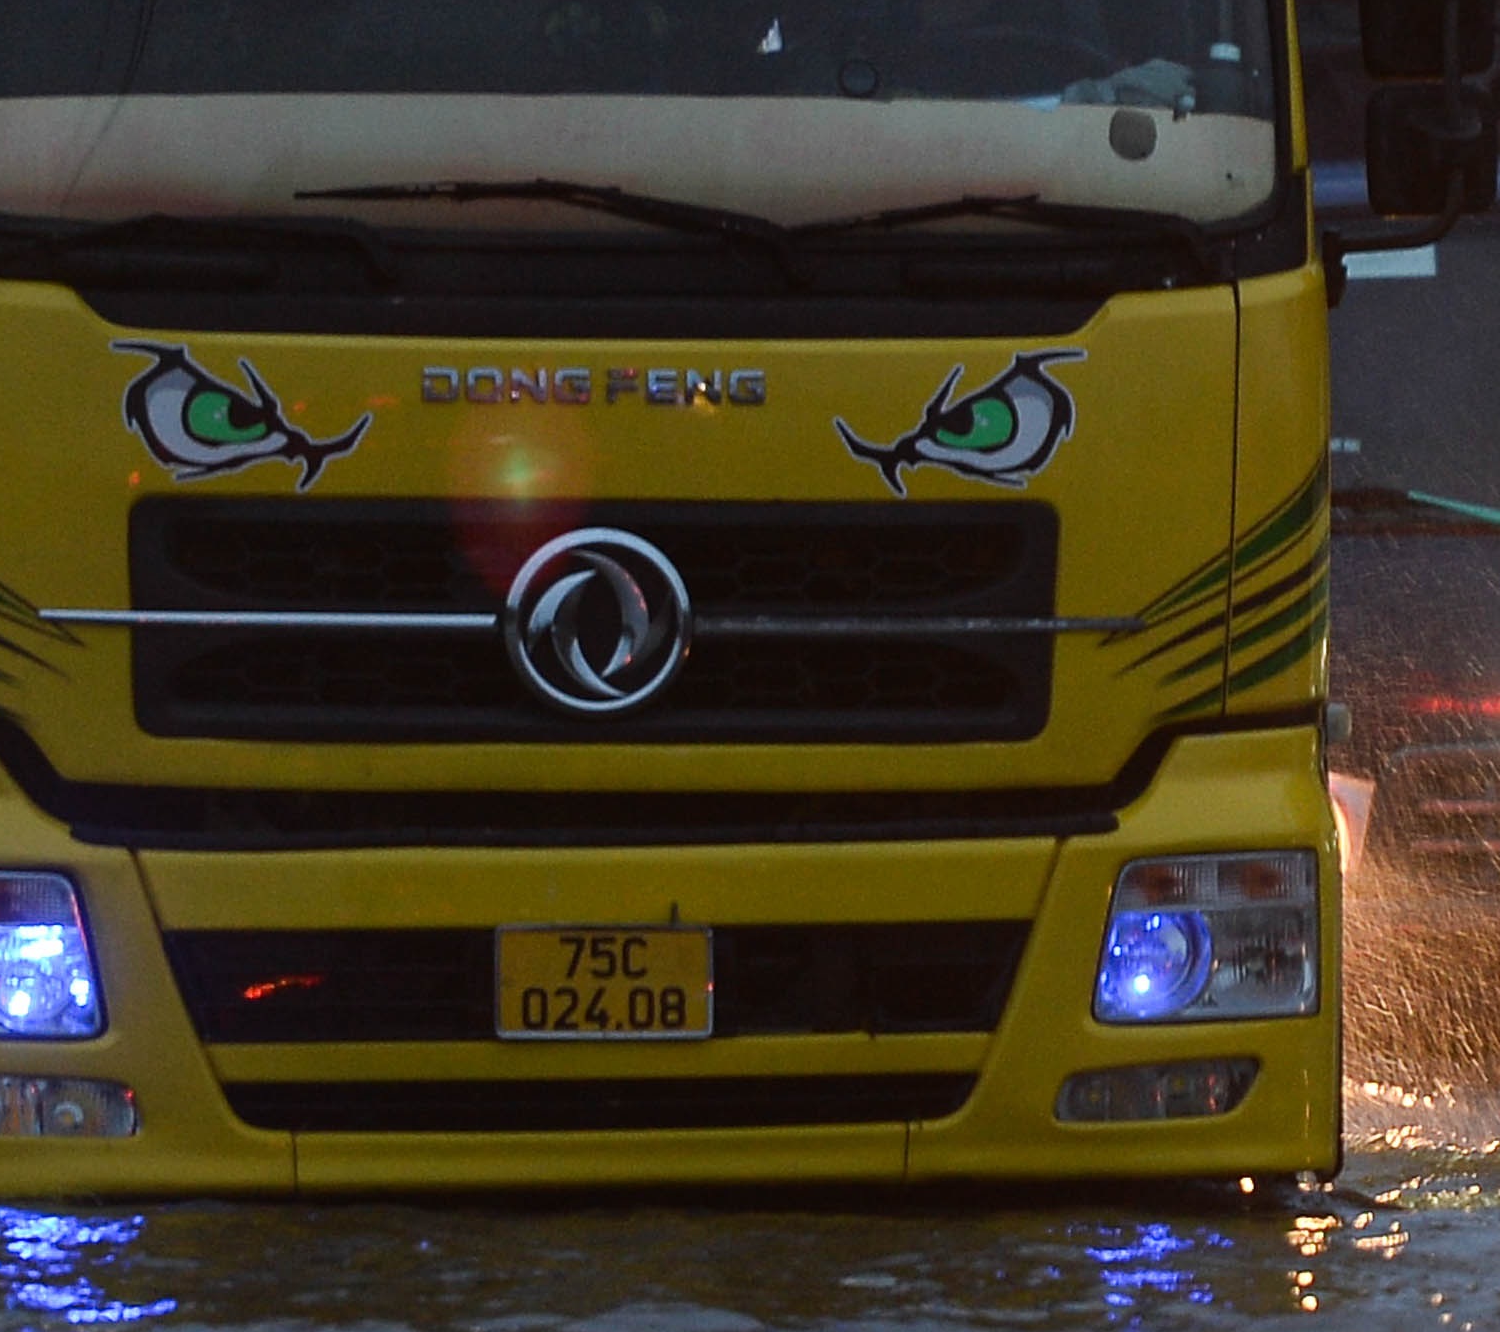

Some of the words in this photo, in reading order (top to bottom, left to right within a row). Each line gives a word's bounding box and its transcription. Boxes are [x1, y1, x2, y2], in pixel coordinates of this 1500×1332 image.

[423, 366, 591, 404] DONG
[607, 366, 766, 405] FENG
[559, 936, 648, 980] 75C
[521, 986, 687, 1030] 024.08
